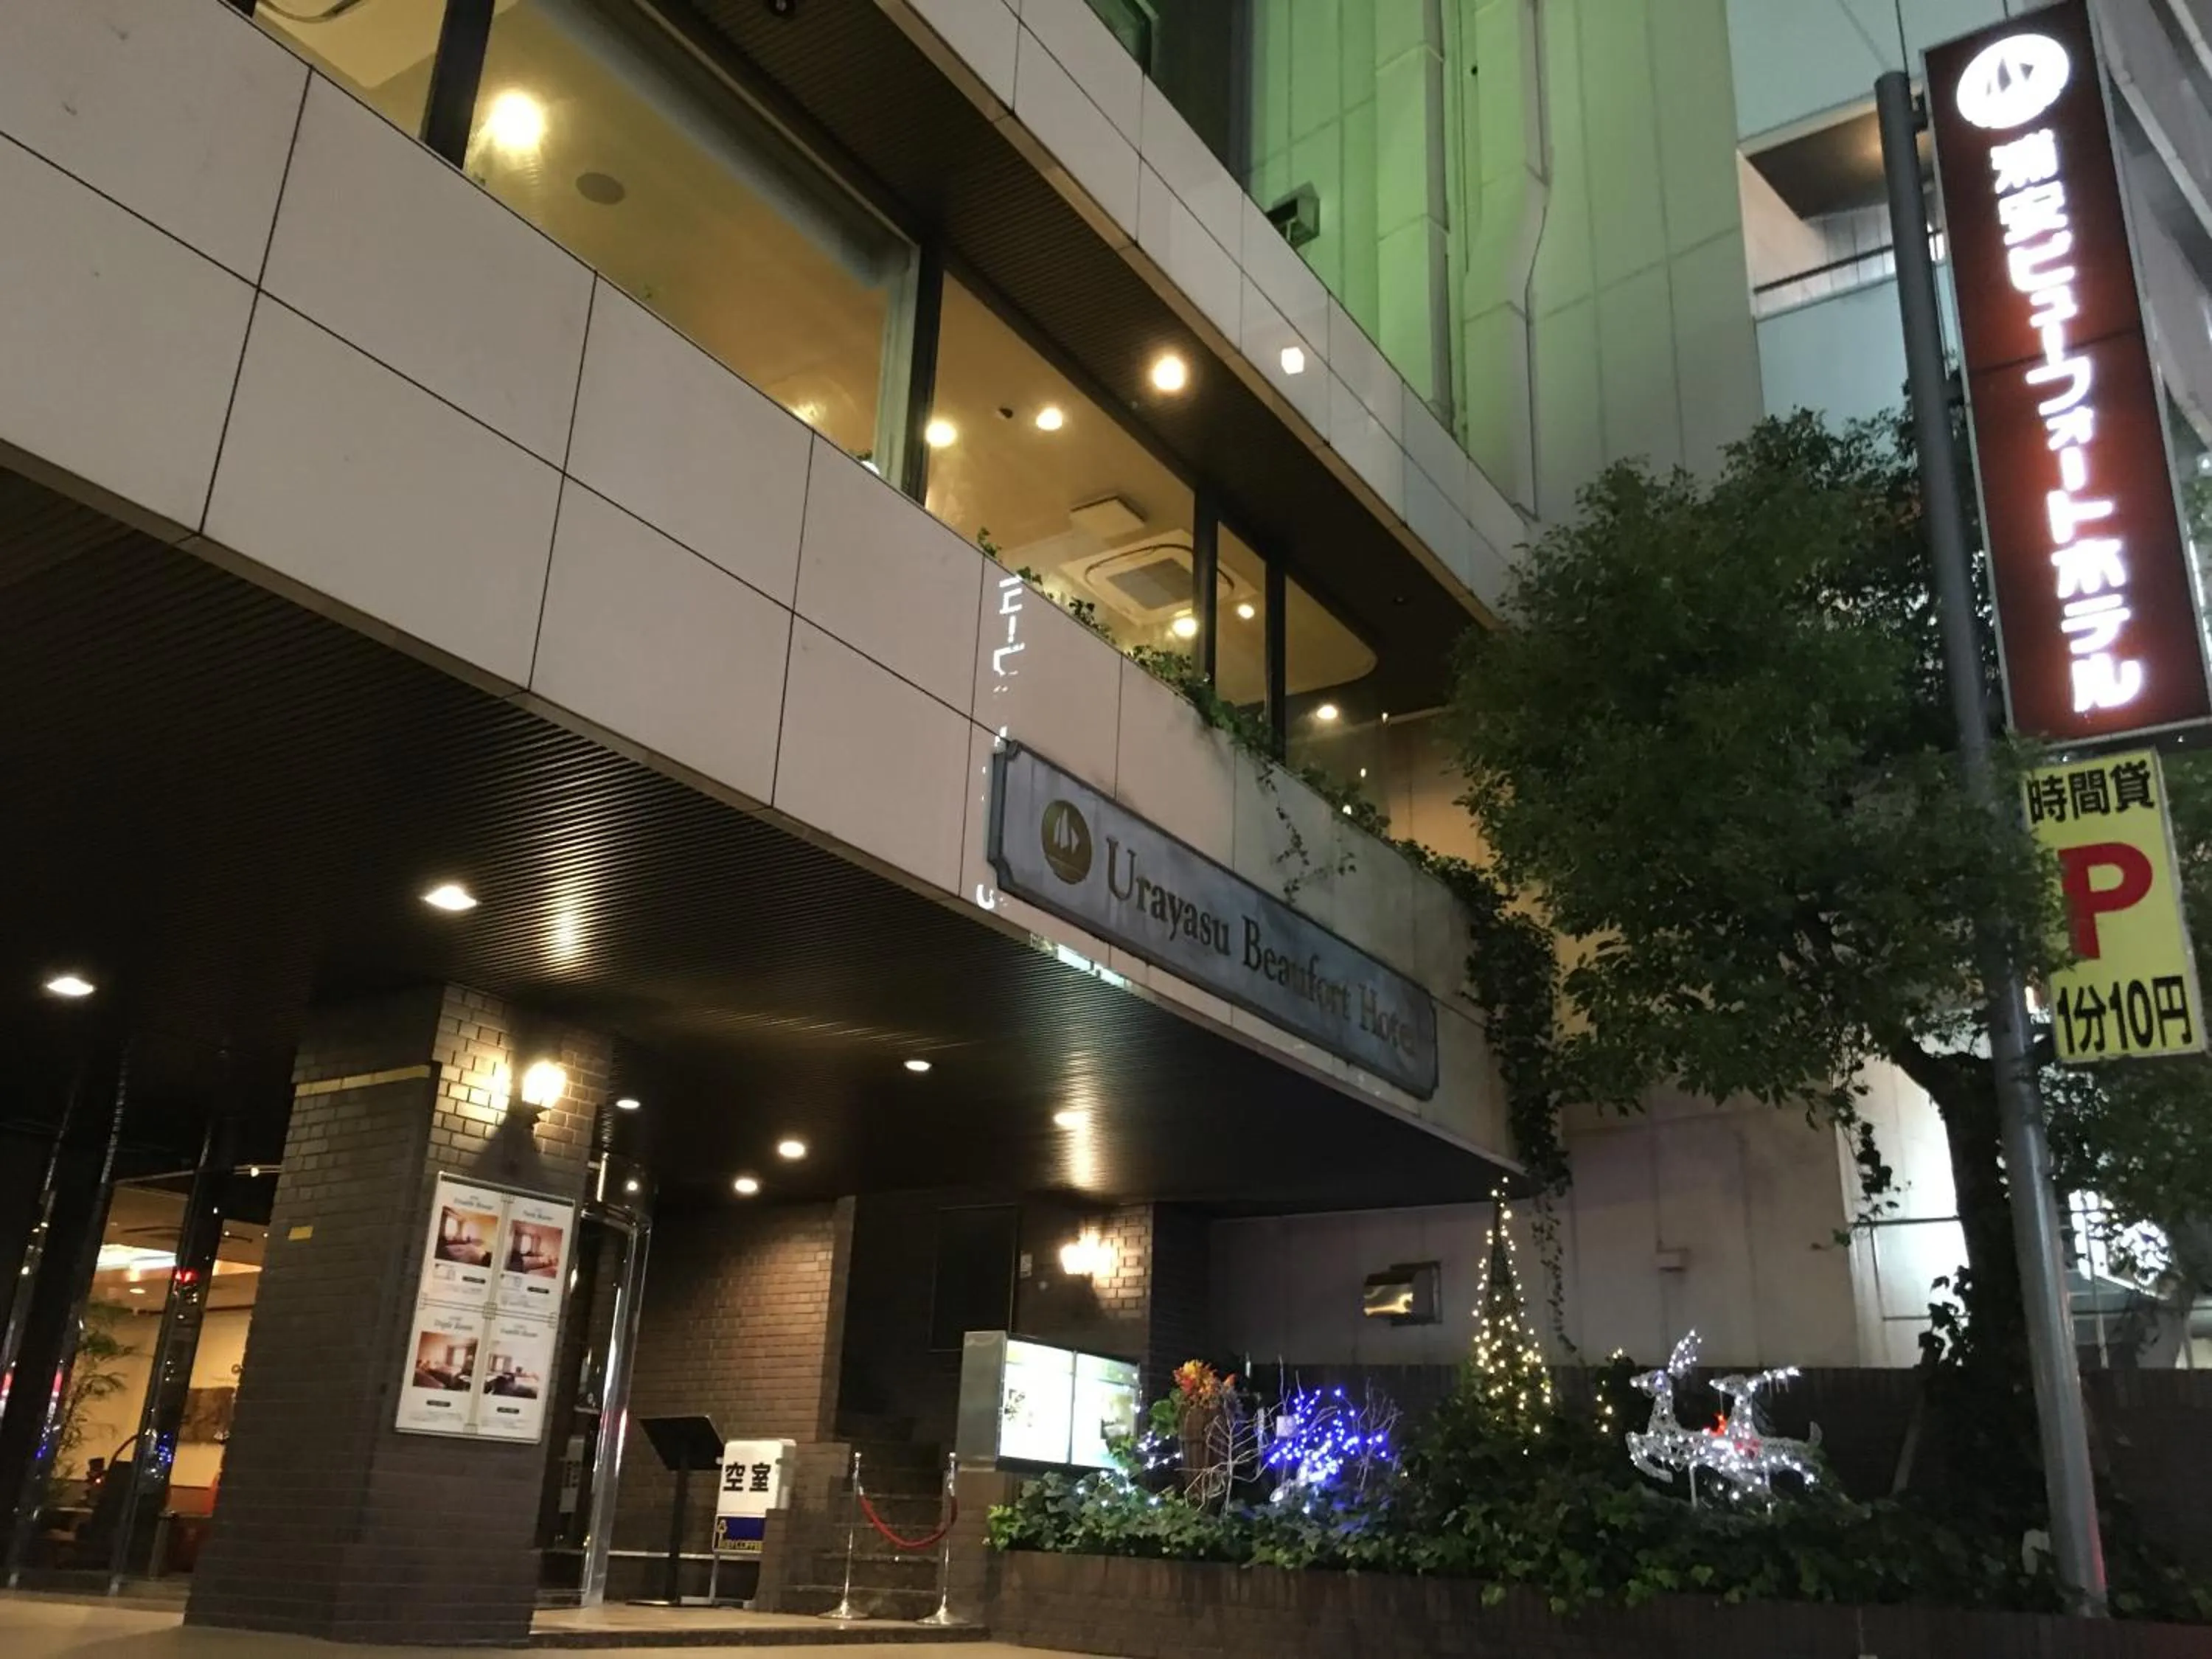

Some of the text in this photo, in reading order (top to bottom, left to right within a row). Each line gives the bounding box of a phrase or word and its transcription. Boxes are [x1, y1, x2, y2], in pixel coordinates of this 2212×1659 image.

[2025, 759, 2154, 825] 時間貸
[2057, 841, 2153, 959] P
[1106, 835, 1417, 1057] Urayasu Beaufort Hote
[2056, 975, 2193, 1055] 1分10円
[723, 1461, 771, 1492] 空室
